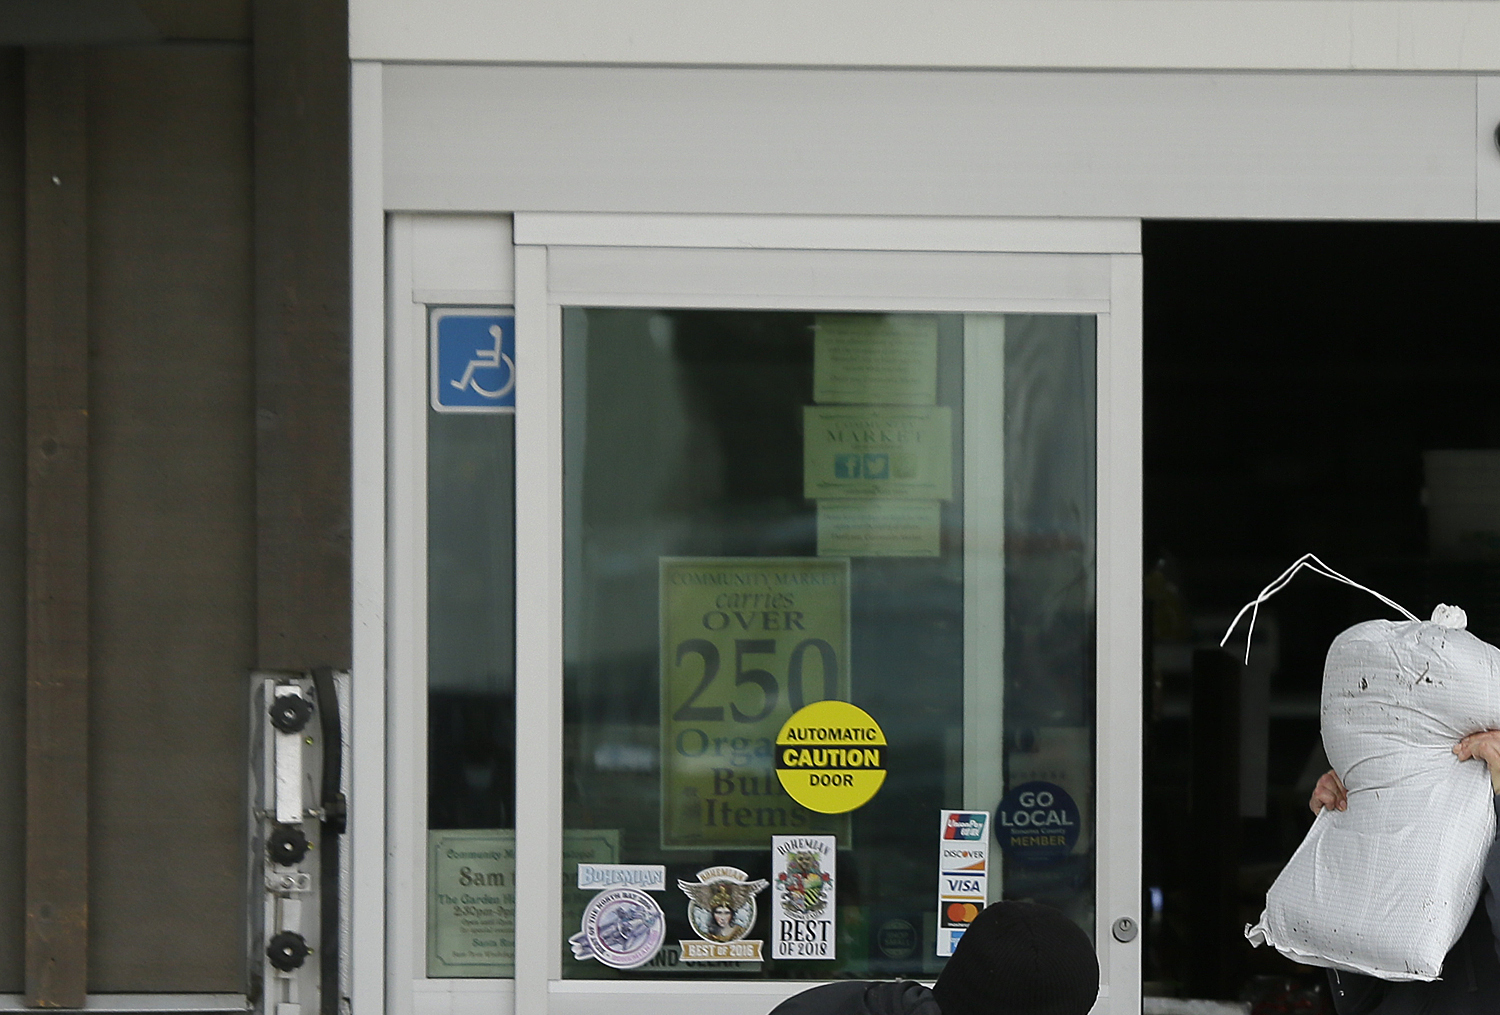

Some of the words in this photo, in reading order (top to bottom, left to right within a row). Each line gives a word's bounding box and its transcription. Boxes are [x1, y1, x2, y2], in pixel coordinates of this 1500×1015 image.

[670, 572, 769, 586] COMMUNITY
[715, 585, 794, 609] carries
[702, 610, 805, 631] OVER
[673, 638, 839, 723] 250
[787, 728, 877, 742] AUTOMATIC
[676, 728, 776, 767] Orga
[782, 748, 881, 768] CAUTION
[713, 767, 783, 797] Bul
[810, 774, 855, 788] DOOR
[1018, 791, 1054, 808] GO
[706, 798, 809, 828] Items
[1001, 810, 1074, 827] LOCAL
[1010, 836, 1066, 847] MEMBER
[943, 849, 984, 859] DISCOVER
[946, 879, 981, 893] VISA
[437, 893, 459, 905] The
[779, 919, 832, 942] BEST
[688, 944, 715, 958] BEST
[717, 946, 728, 956] OF
[779, 942, 796, 956] OF
[797, 942, 828, 956] 2018
